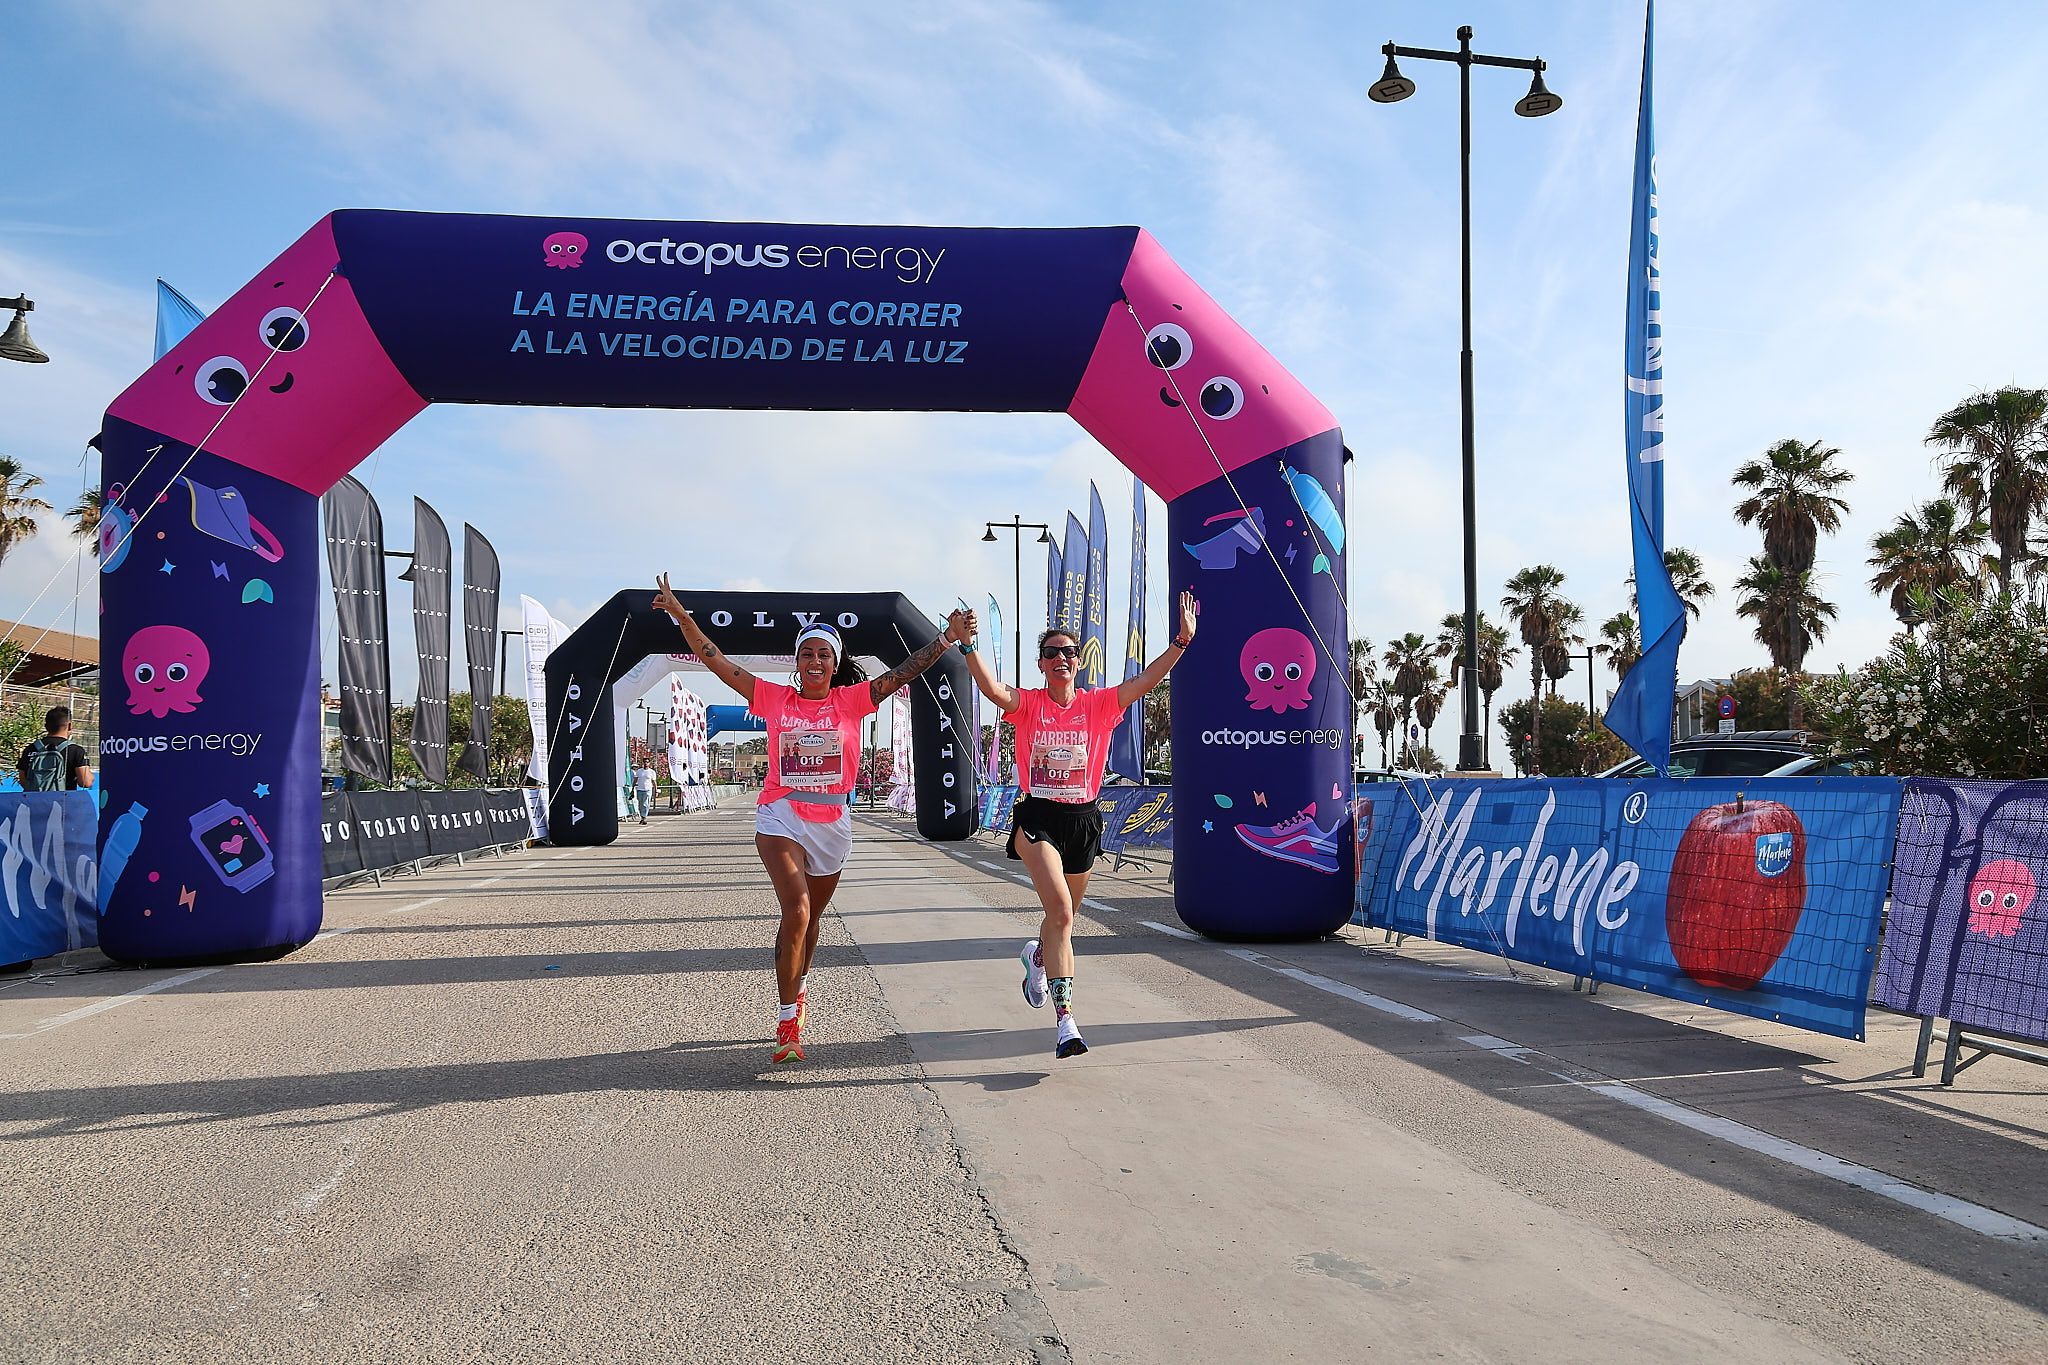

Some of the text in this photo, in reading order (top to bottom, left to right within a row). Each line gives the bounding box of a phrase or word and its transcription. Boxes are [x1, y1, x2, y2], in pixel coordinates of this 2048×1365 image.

[606, 238, 946, 283] octopus energy
[512, 291, 963, 327] LA ENERGÍA PARA CORRER
[510, 329, 969, 363] A LA VELOCIDAD DE LA LUZ
[664, 610, 859, 628] VOLVO
[781, 714, 834, 729] CARRERA
[100, 733, 262, 758] octopus energy
[1033, 730, 1087, 746] CARRERA
[1201, 728, 1344, 750] octopus energy
[568, 684, 585, 826] VOLVO
[800, 756, 824, 765] 016
[938, 684, 957, 820] VOLVO
[1048, 769, 1070, 779] 016
[361, 814, 420, 839] VOLVO
[427, 809, 483, 830] VOLVO
[488, 806, 526, 824] VOLVO
[1758, 843, 1791, 868] Marlene
[1396, 787, 1640, 956] Marlene
